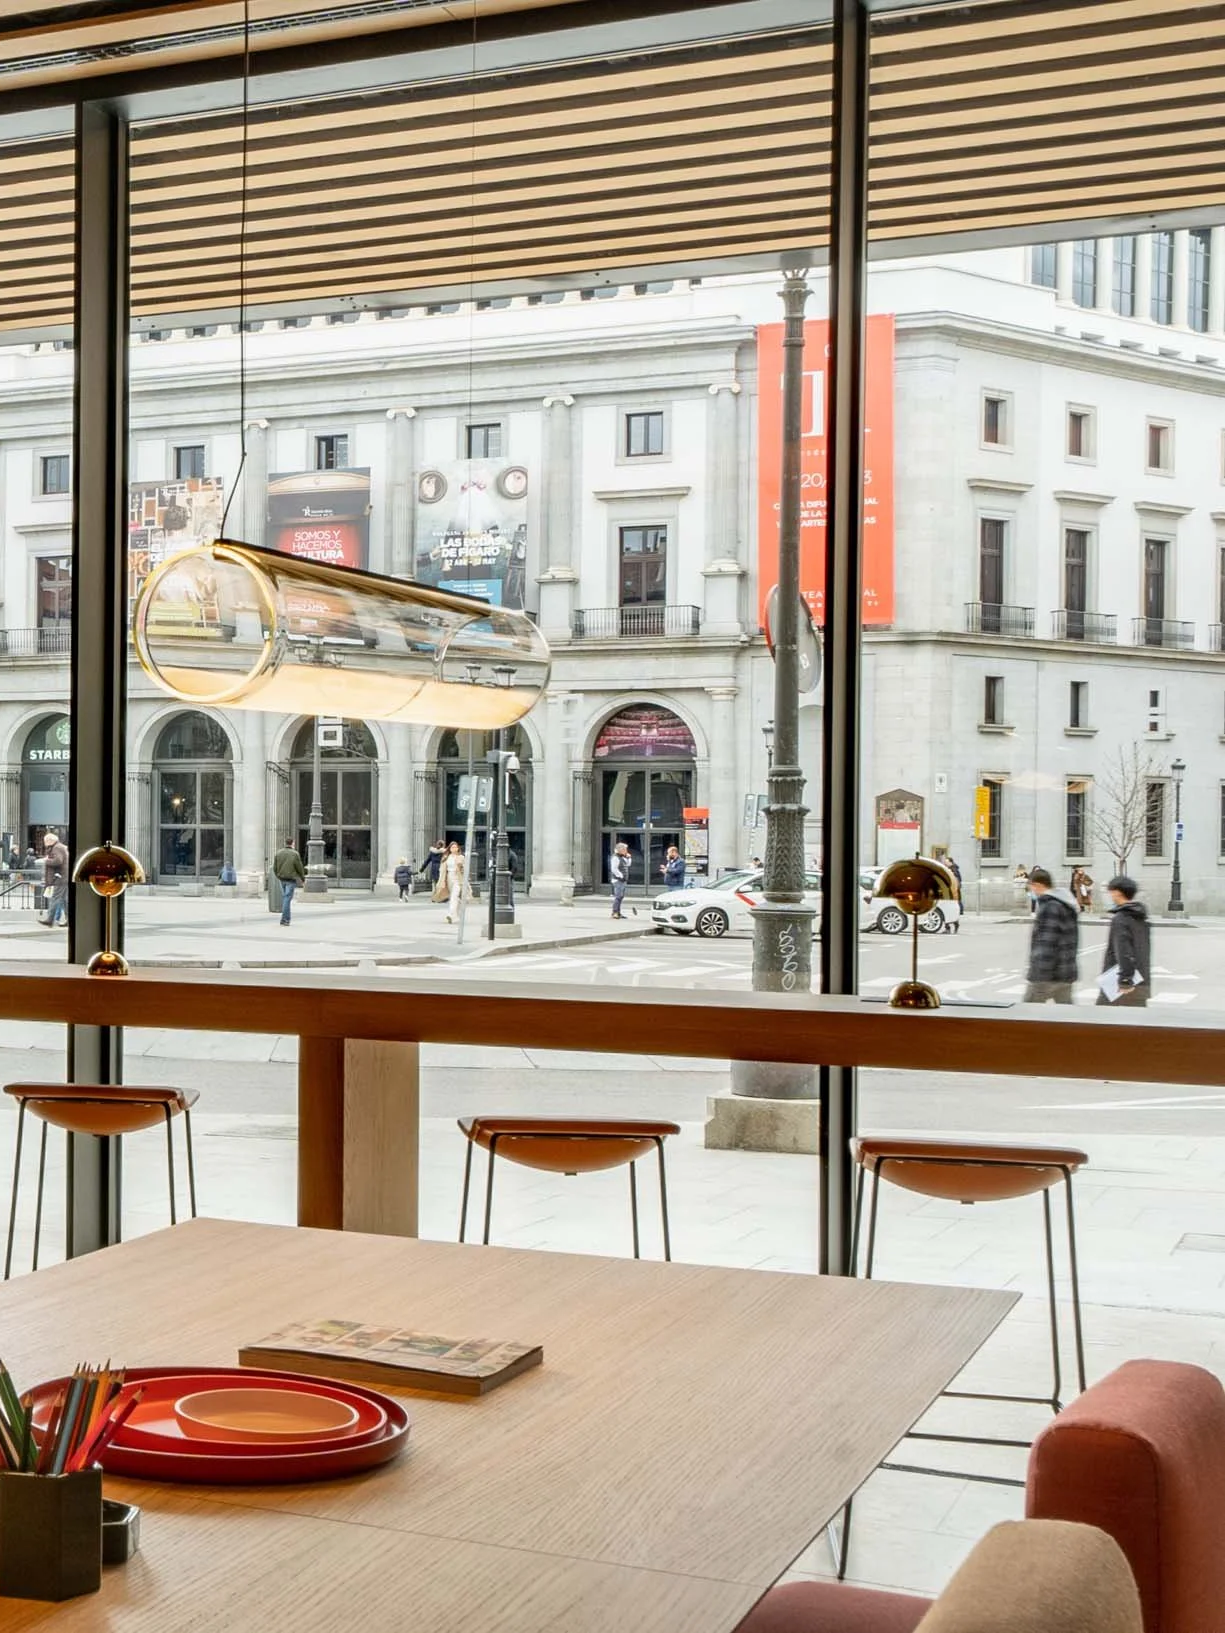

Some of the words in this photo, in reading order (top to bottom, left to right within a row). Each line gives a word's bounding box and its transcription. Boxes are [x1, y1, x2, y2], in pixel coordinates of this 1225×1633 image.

[294, 531, 330, 541] SOMOS
[333, 530, 341, 539] Y
[292, 540, 342, 550] HACEMOS
[440, 538, 462, 548] LAS
[441, 548, 456, 558] DE
[803, 591, 824, 599] TEA
[29, 750, 70, 760] STARB
